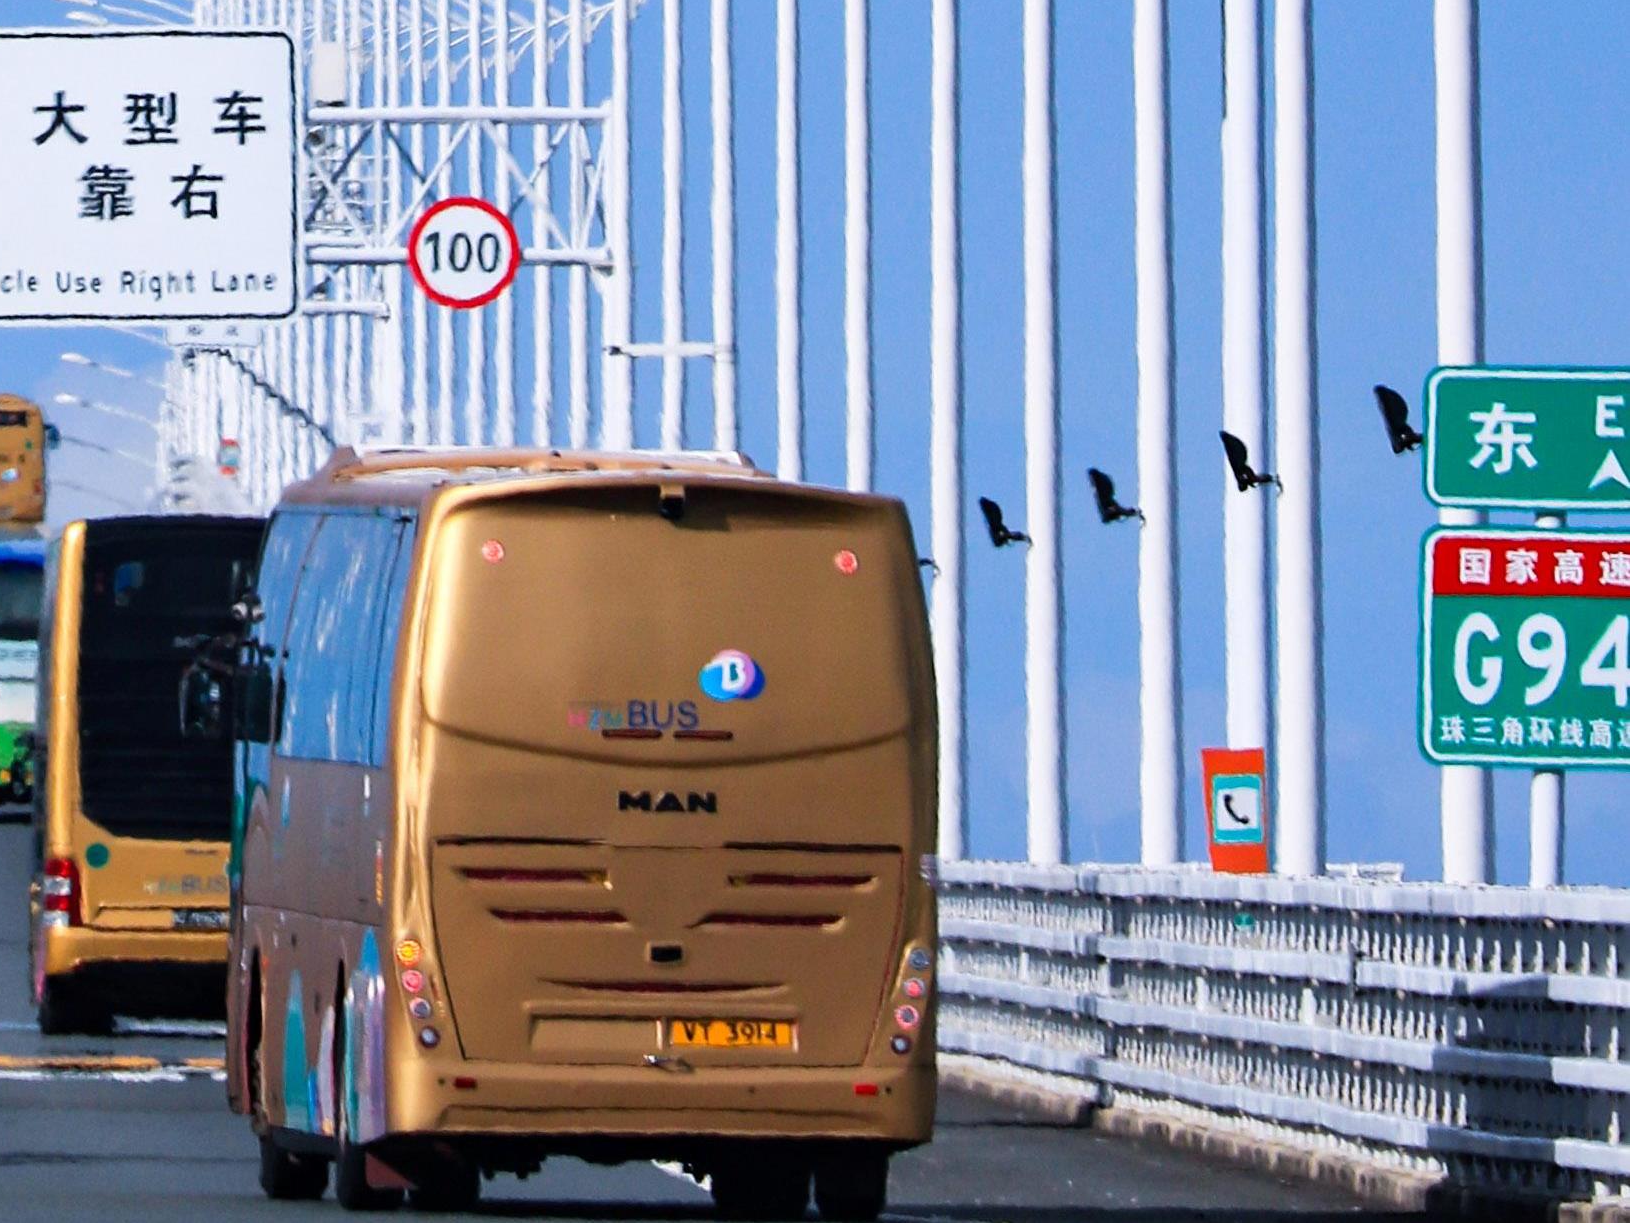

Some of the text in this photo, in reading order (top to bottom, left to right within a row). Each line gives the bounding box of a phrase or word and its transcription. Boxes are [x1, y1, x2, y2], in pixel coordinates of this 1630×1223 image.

[32, 90, 267, 147] 大型车
[78, 163, 225, 222] 靠右
[424, 231, 501, 273] 100
[55, 271, 102, 295] Use
[120, 270, 196, 301] Right
[211, 270, 278, 293] Lane
[1468, 402, 1538, 475] 东
[1595, 395, 1626, 439] E
[1458, 547, 1630, 587] 国家高速
[1453, 612, 1630, 708] G94
[618, 790, 719, 814] MAN
